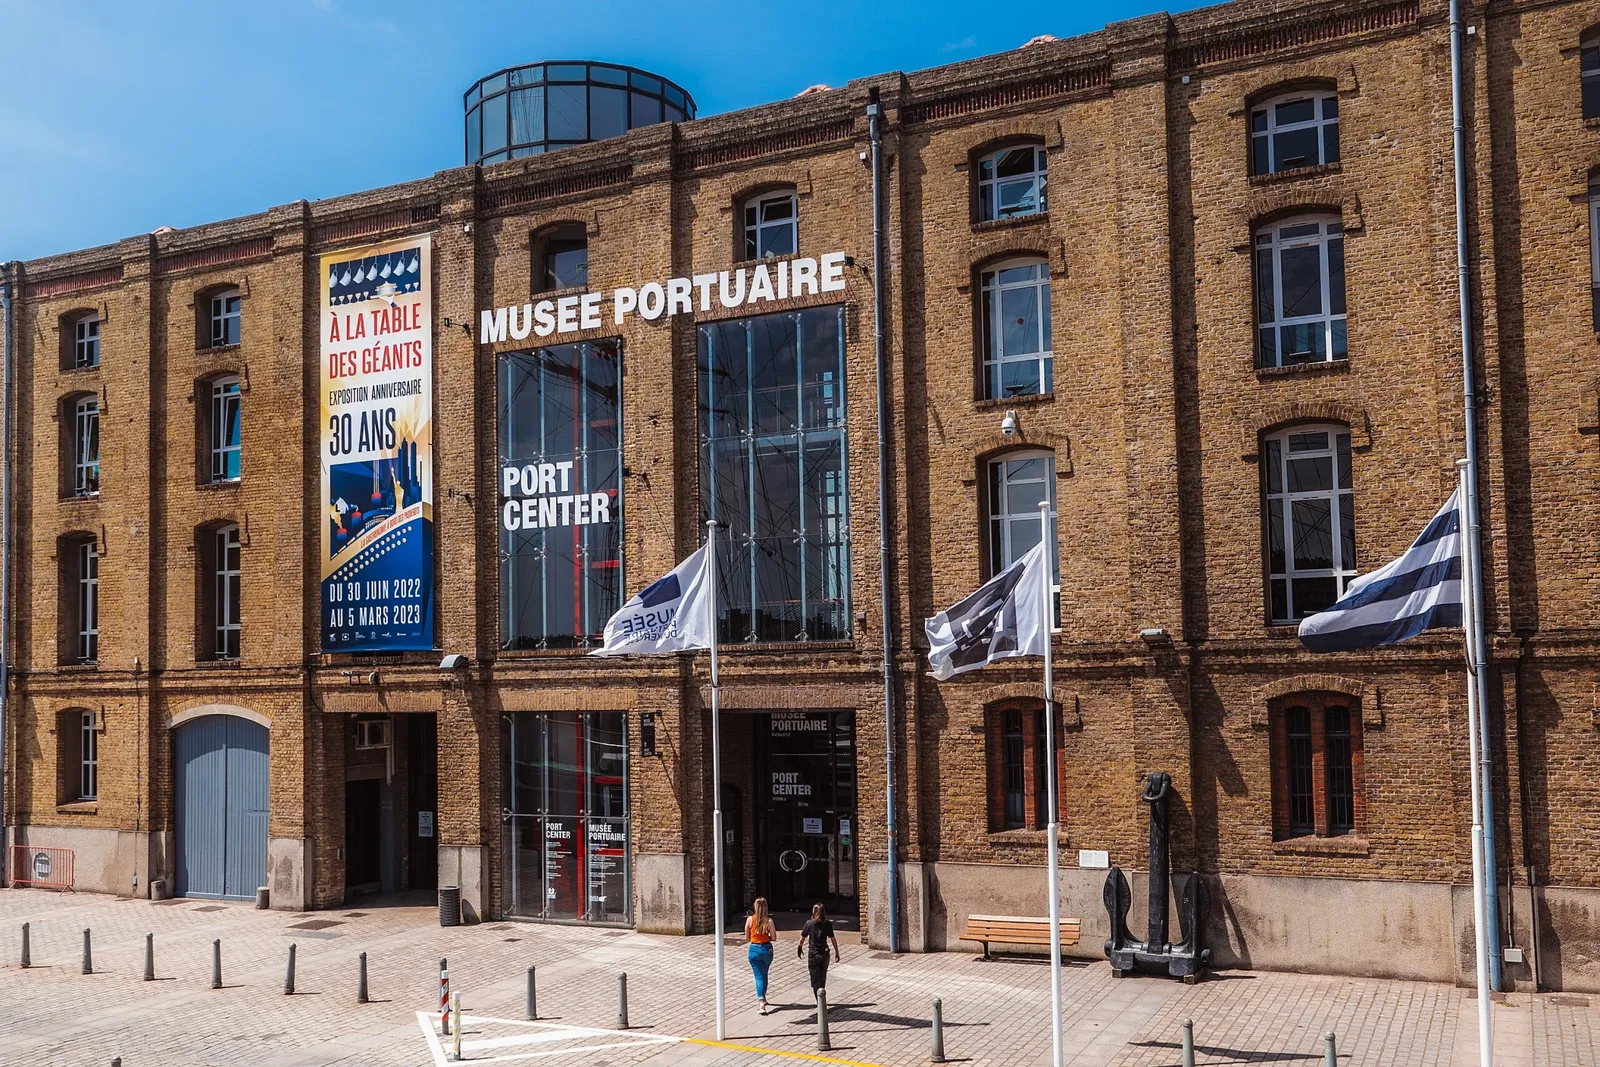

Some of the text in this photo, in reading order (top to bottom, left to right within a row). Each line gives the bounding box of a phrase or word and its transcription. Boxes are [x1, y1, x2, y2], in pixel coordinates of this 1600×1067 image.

[480, 251, 845, 345] MUSEE PORTUAIRE
[329, 302, 421, 343] À LA TABLE
[329, 340, 422, 379] DES GÉANTS
[329, 378, 422, 406] EXPOSITION ANNIVERSAIRE
[329, 407, 396, 456] 30 ANS
[503, 461, 573, 497] PORT
[503, 492, 610, 531] CENTER
[329, 578, 420, 602] DU 30 JUIN 2022
[329, 604, 420, 628] AU 5 MARS 2023
[771, 720, 828, 731] PORTUAIRE
[772, 772, 799, 783] PORT
[772, 784, 812, 795] CENTER
[545, 823, 563, 831] PORT
[545, 831, 571, 839] CENTER
[588, 822, 612, 832] MUSÉE
[588, 832, 626, 841] PORTUAIRE
